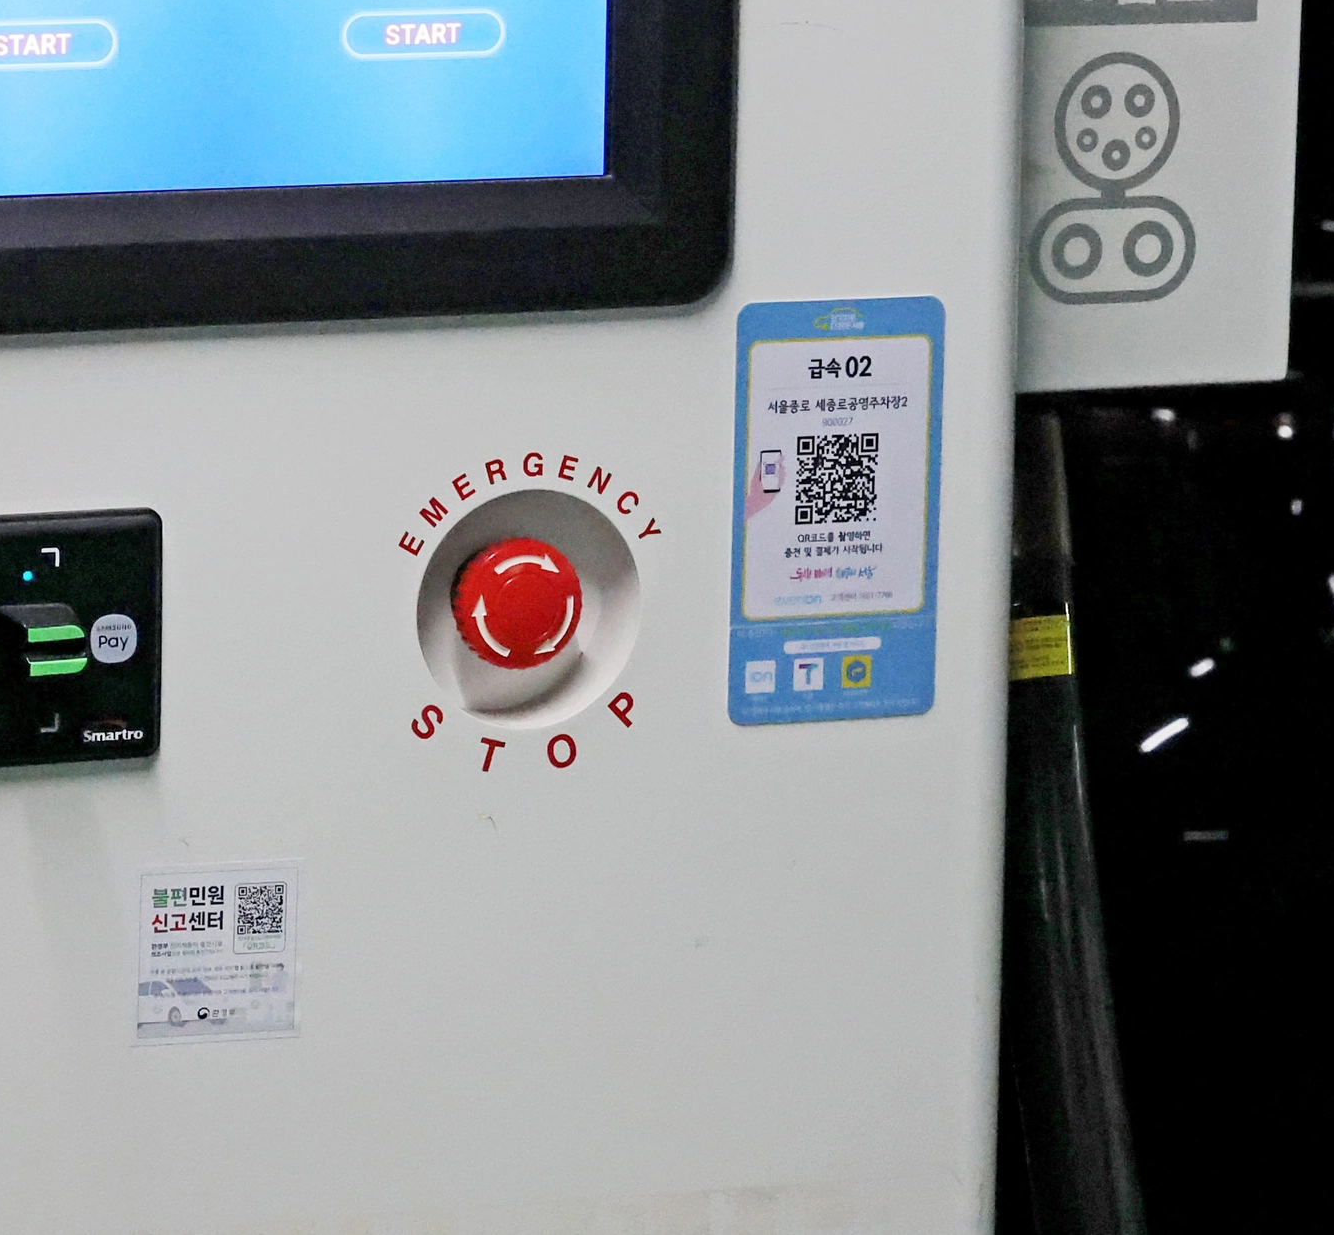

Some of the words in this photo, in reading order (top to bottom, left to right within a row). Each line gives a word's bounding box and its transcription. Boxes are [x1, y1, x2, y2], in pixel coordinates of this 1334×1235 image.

[385, 22, 462, 47] START
[808, 357, 842, 380] 급속
[845, 355, 872, 378] 02
[767, 399, 811, 414] 서울종로
[398, 452, 662, 558] EMERGENCY
[98, 635, 129, 651] Pay
[83, 729, 144, 744] Smartro
[411, 691, 635, 773] STOP
[151, 885, 225, 909] 불편민원
[151, 910, 224, 934] 신고센터
